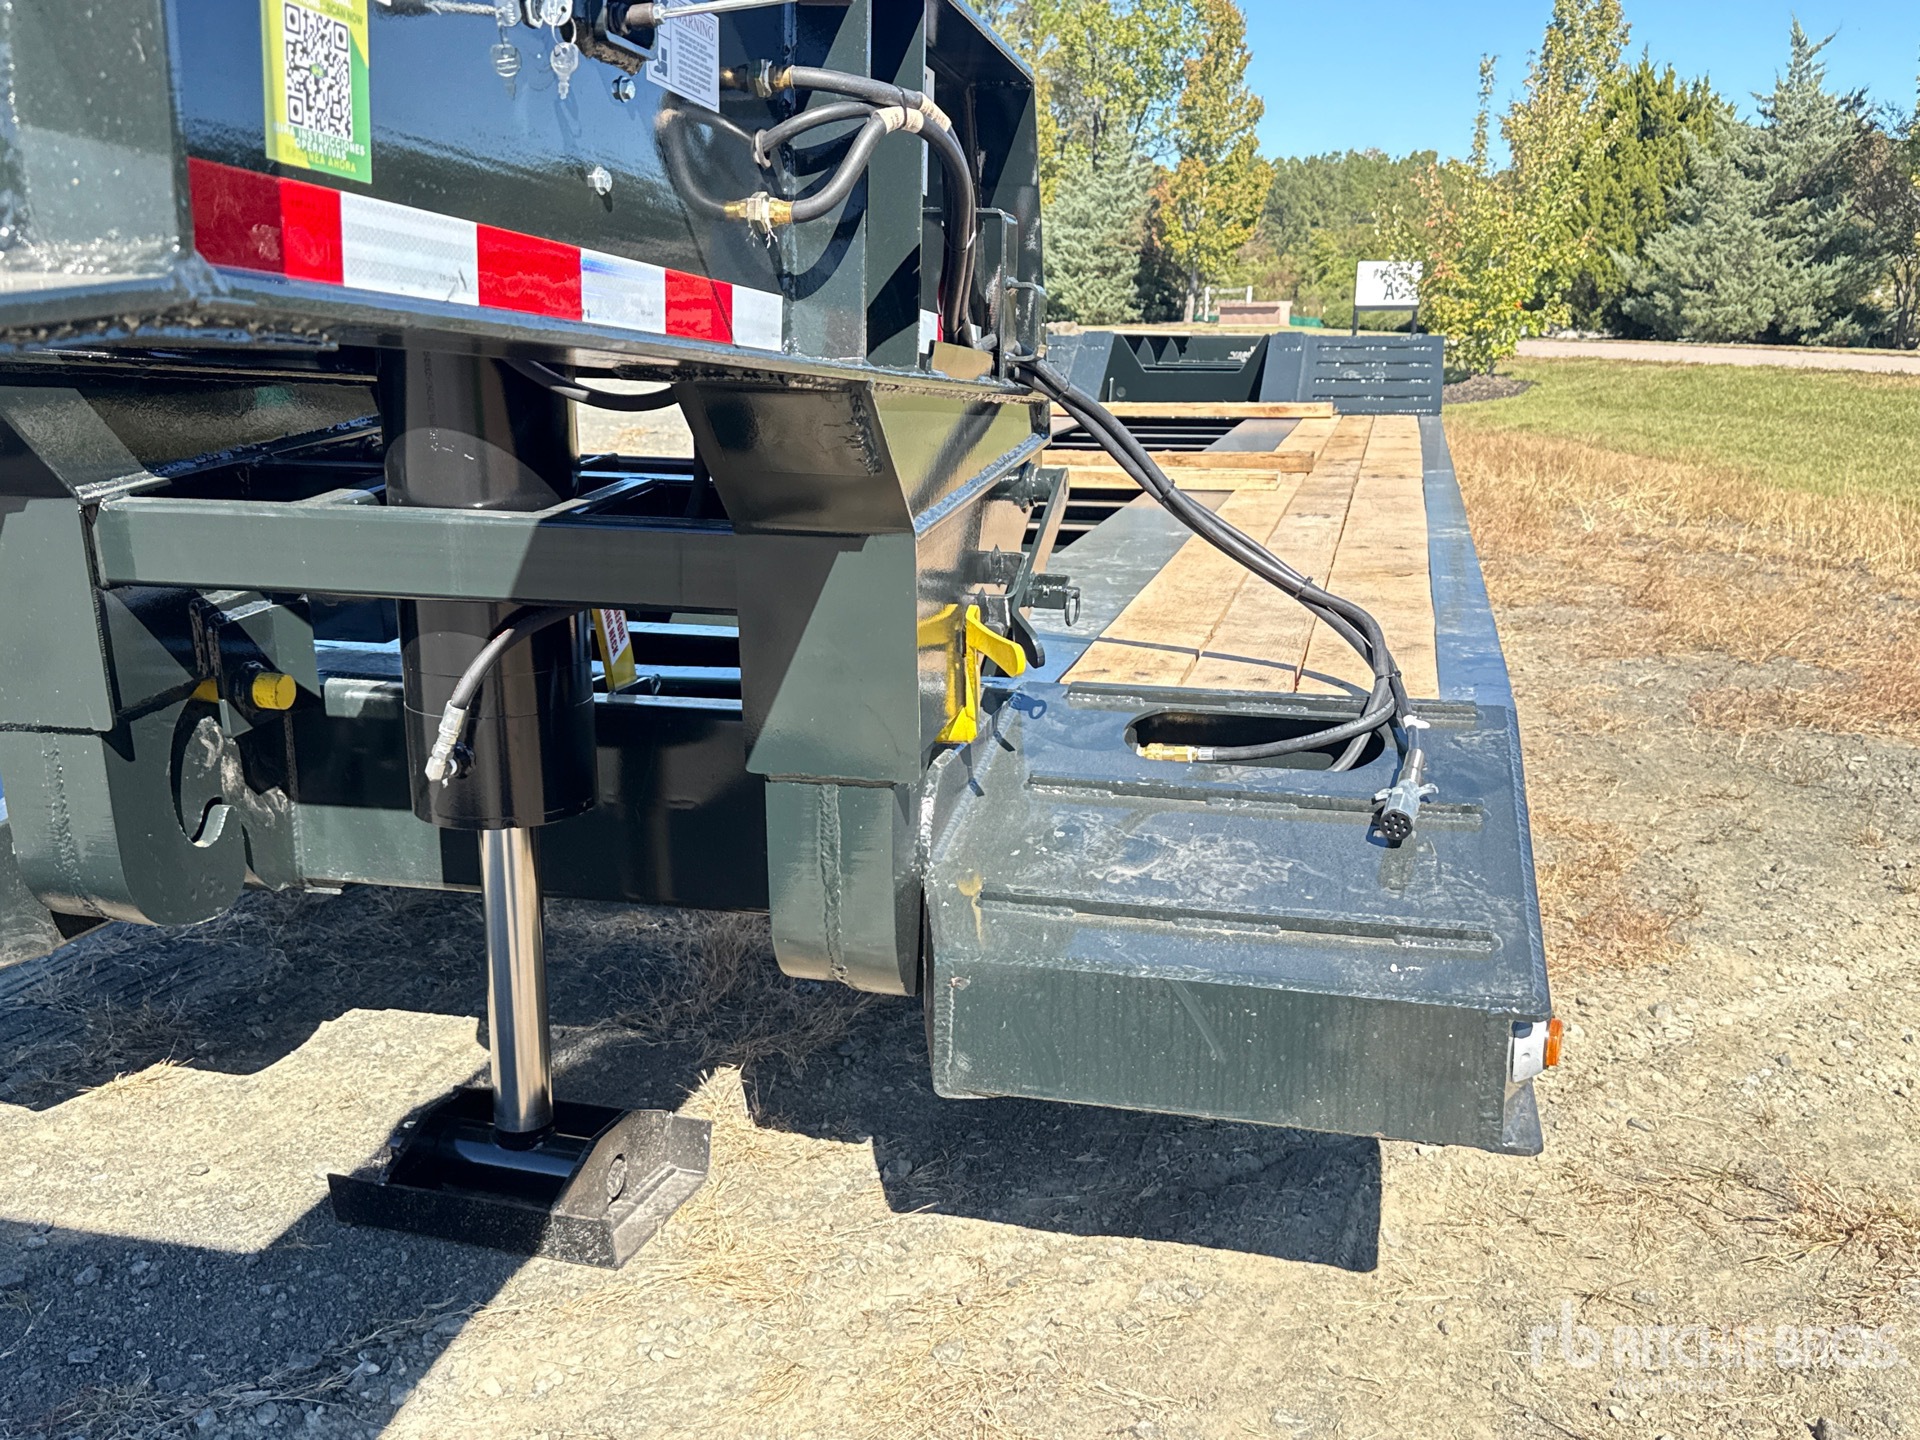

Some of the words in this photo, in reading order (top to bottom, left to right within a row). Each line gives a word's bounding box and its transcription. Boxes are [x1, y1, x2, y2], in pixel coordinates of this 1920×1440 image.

[326, 2, 345, 19] SCAN
[347, 10, 363, 26] NOW
[295, 138, 347, 161] OPERATIVAS
[298, 126, 366, 157] INSTRUCCIONES
[327, 157, 357, 174] AHORA
